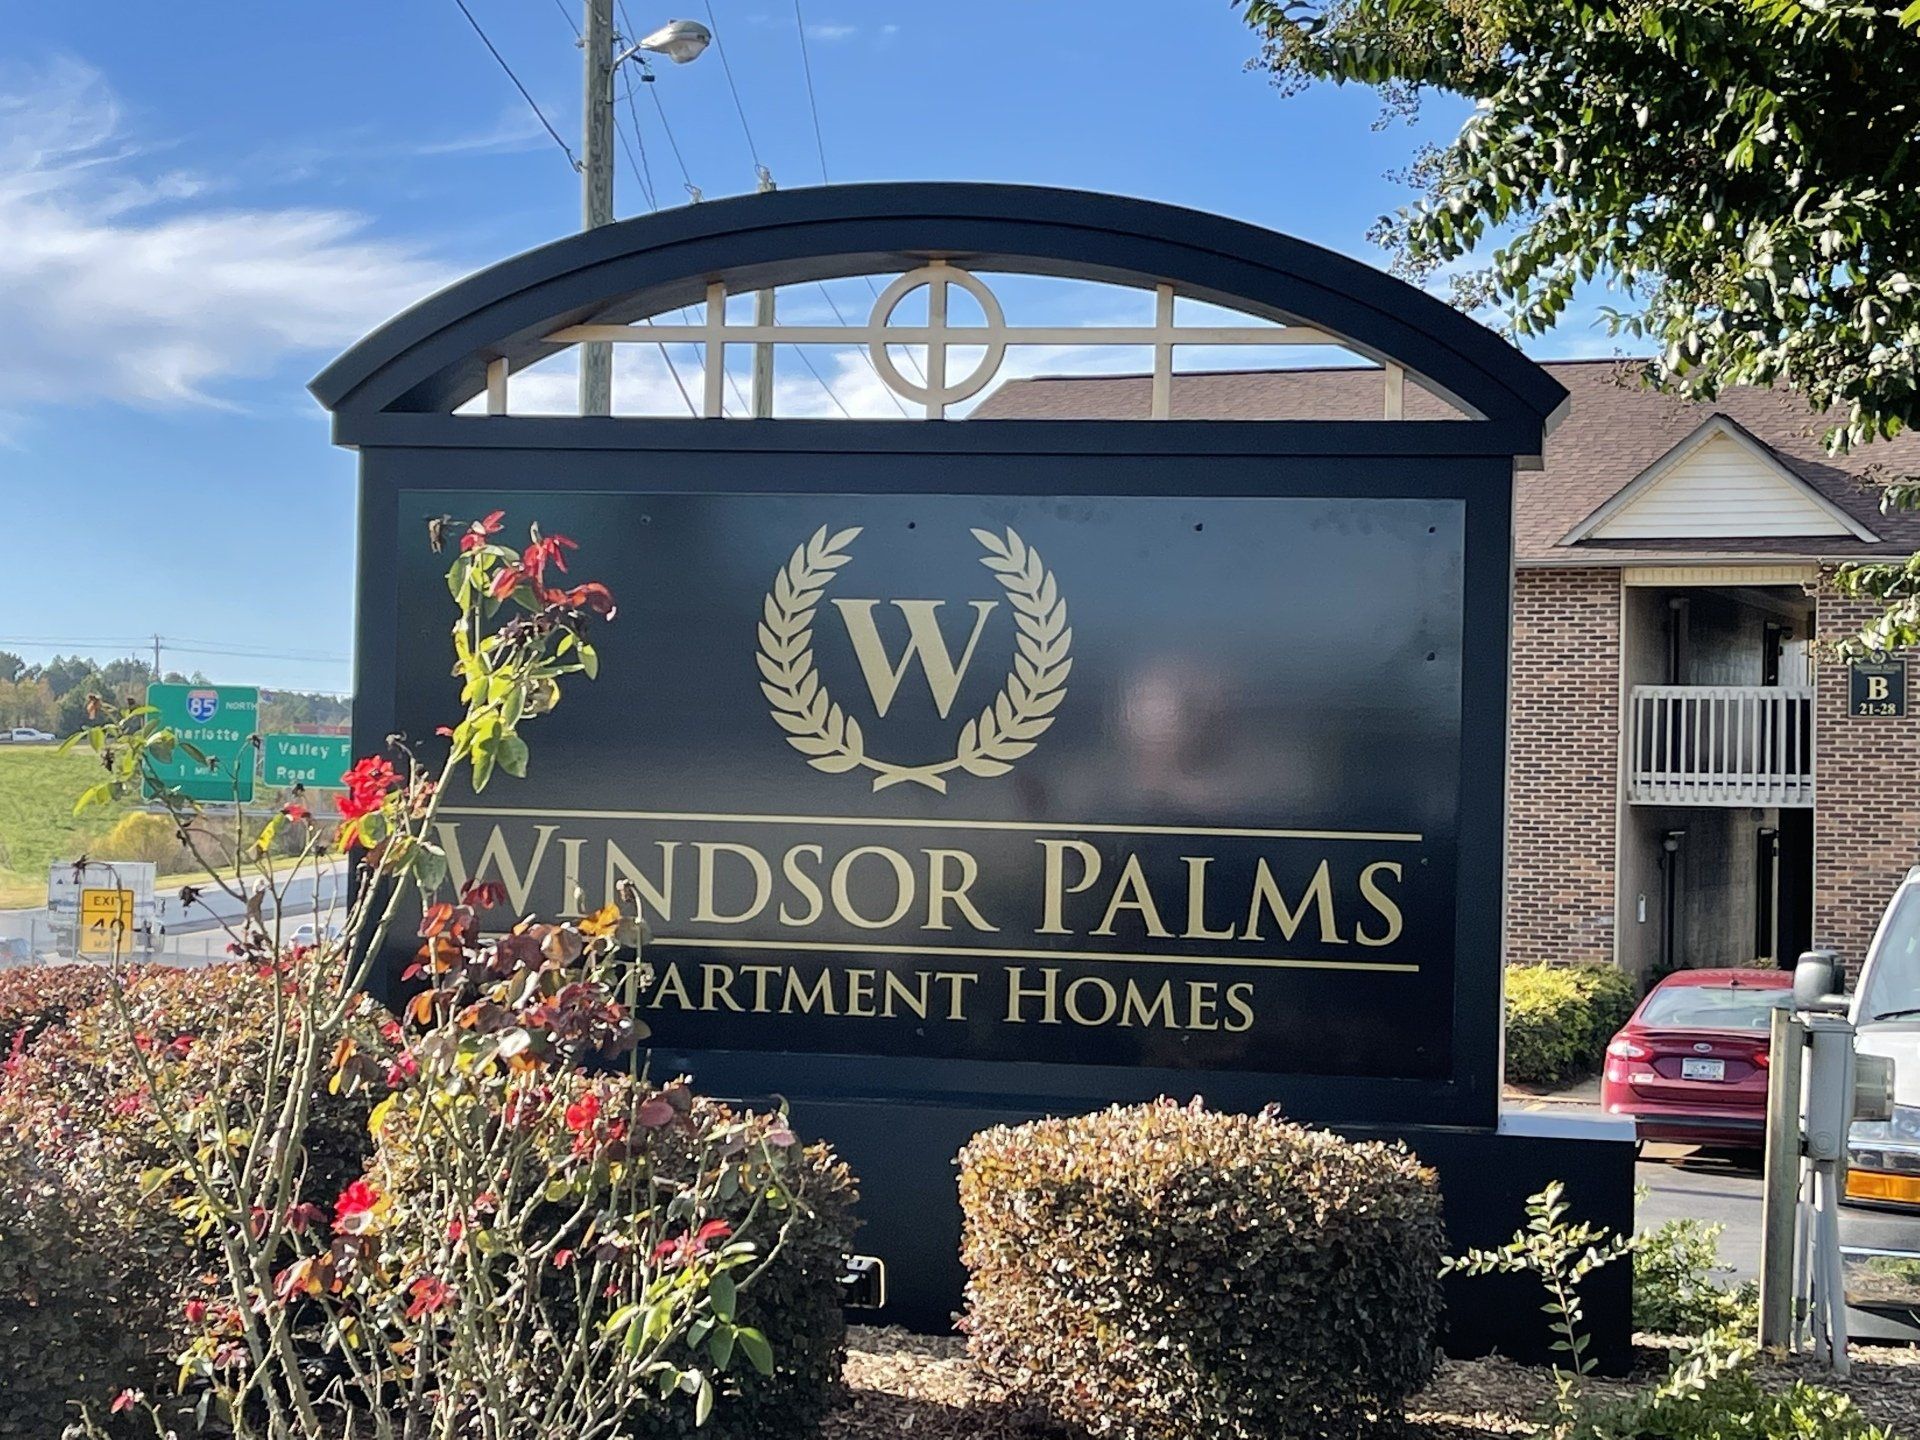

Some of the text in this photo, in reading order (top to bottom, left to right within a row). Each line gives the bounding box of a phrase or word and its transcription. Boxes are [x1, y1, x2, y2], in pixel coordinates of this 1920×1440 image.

[831, 599, 998, 719] W
[1867, 676, 1889, 700] B
[190, 698, 215, 716] 85
[225, 702, 257, 711] NORTH
[1859, 703, 1896, 715] 21-28
[166, 727, 239, 741] harlotte
[278, 742, 329, 759] Valley
[179, 764, 185, 776] 1
[276, 766, 315, 780] Road
[434, 822, 1403, 947] WINDSOR PALMS
[615, 961, 1255, 1032] PARTMENT HOMES
